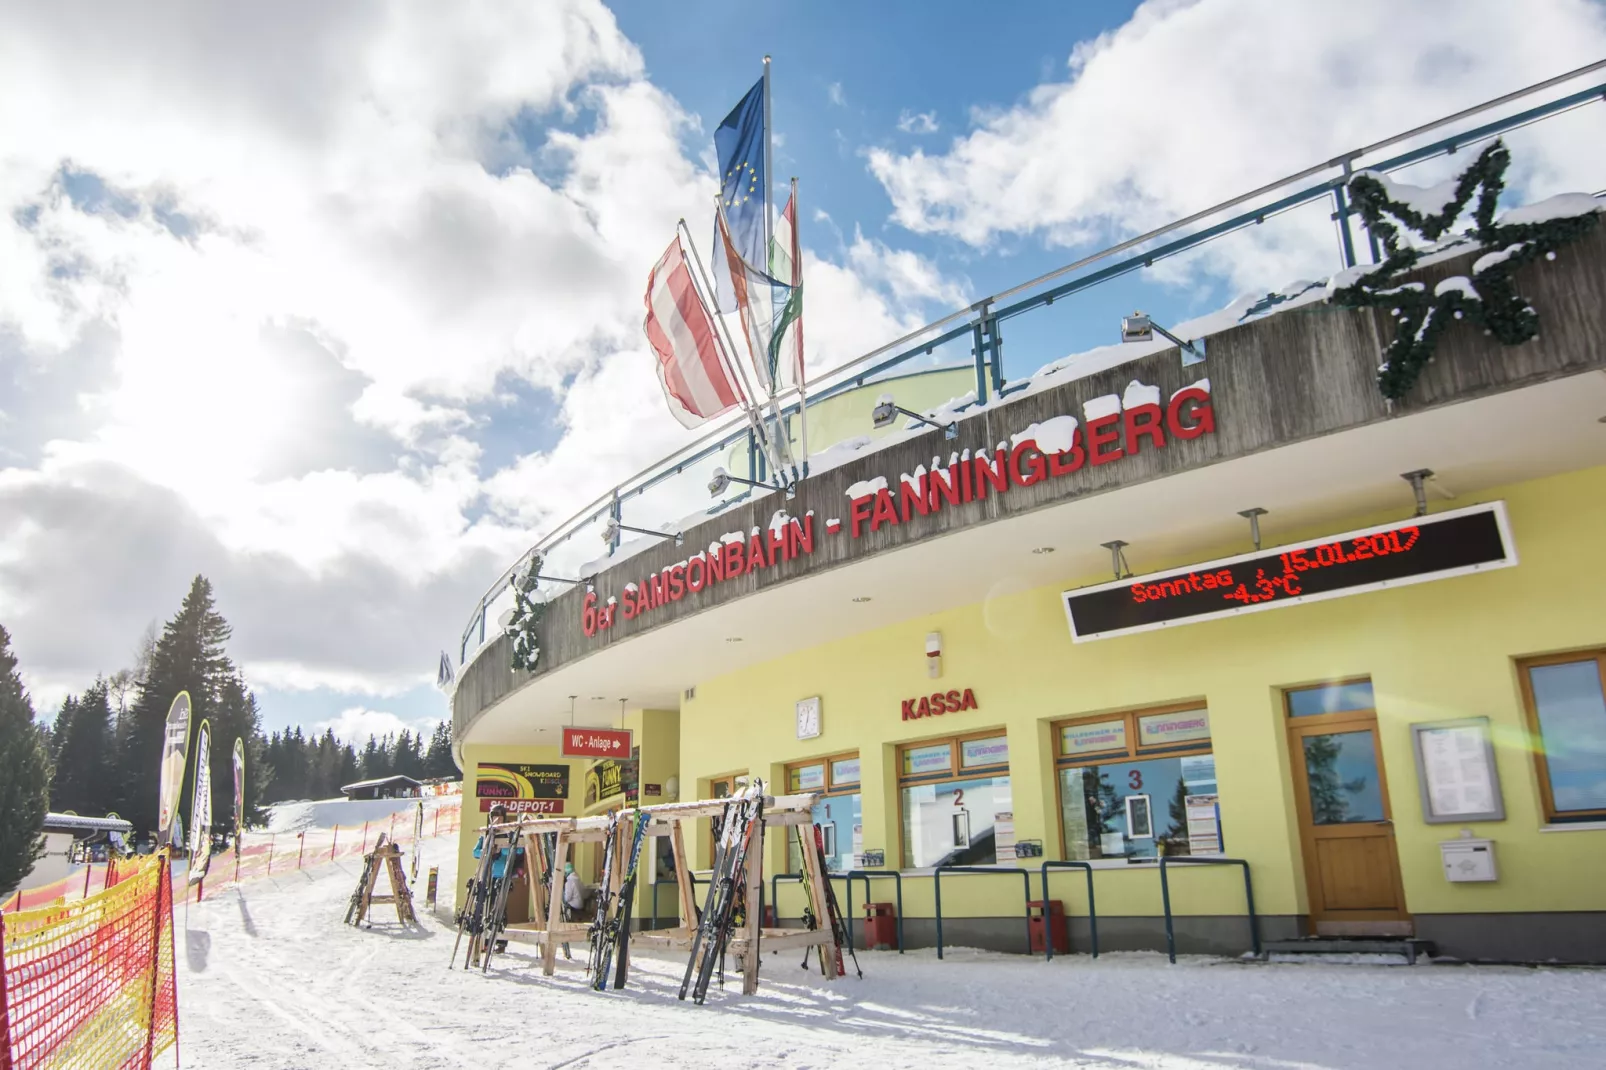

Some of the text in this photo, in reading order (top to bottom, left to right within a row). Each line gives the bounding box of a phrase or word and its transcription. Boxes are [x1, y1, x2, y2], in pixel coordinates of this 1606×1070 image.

[581, 591, 616, 638] 6er
[621, 513, 814, 620] SAMSONBAHN
[848, 386, 1215, 538] FANNINGBERG
[1131, 569, 1233, 603] Sonntag
[1280, 526, 1420, 573] 15.01.2017
[901, 688, 978, 721] KASSA
[571, 734, 584, 748] WC
[588, 735, 611, 752] Anlage
[1128, 770, 1143, 790] 3
[478, 786, 509, 796] FUNNY
[953, 788, 965, 806] 2
[824, 804, 830, 819] 1
